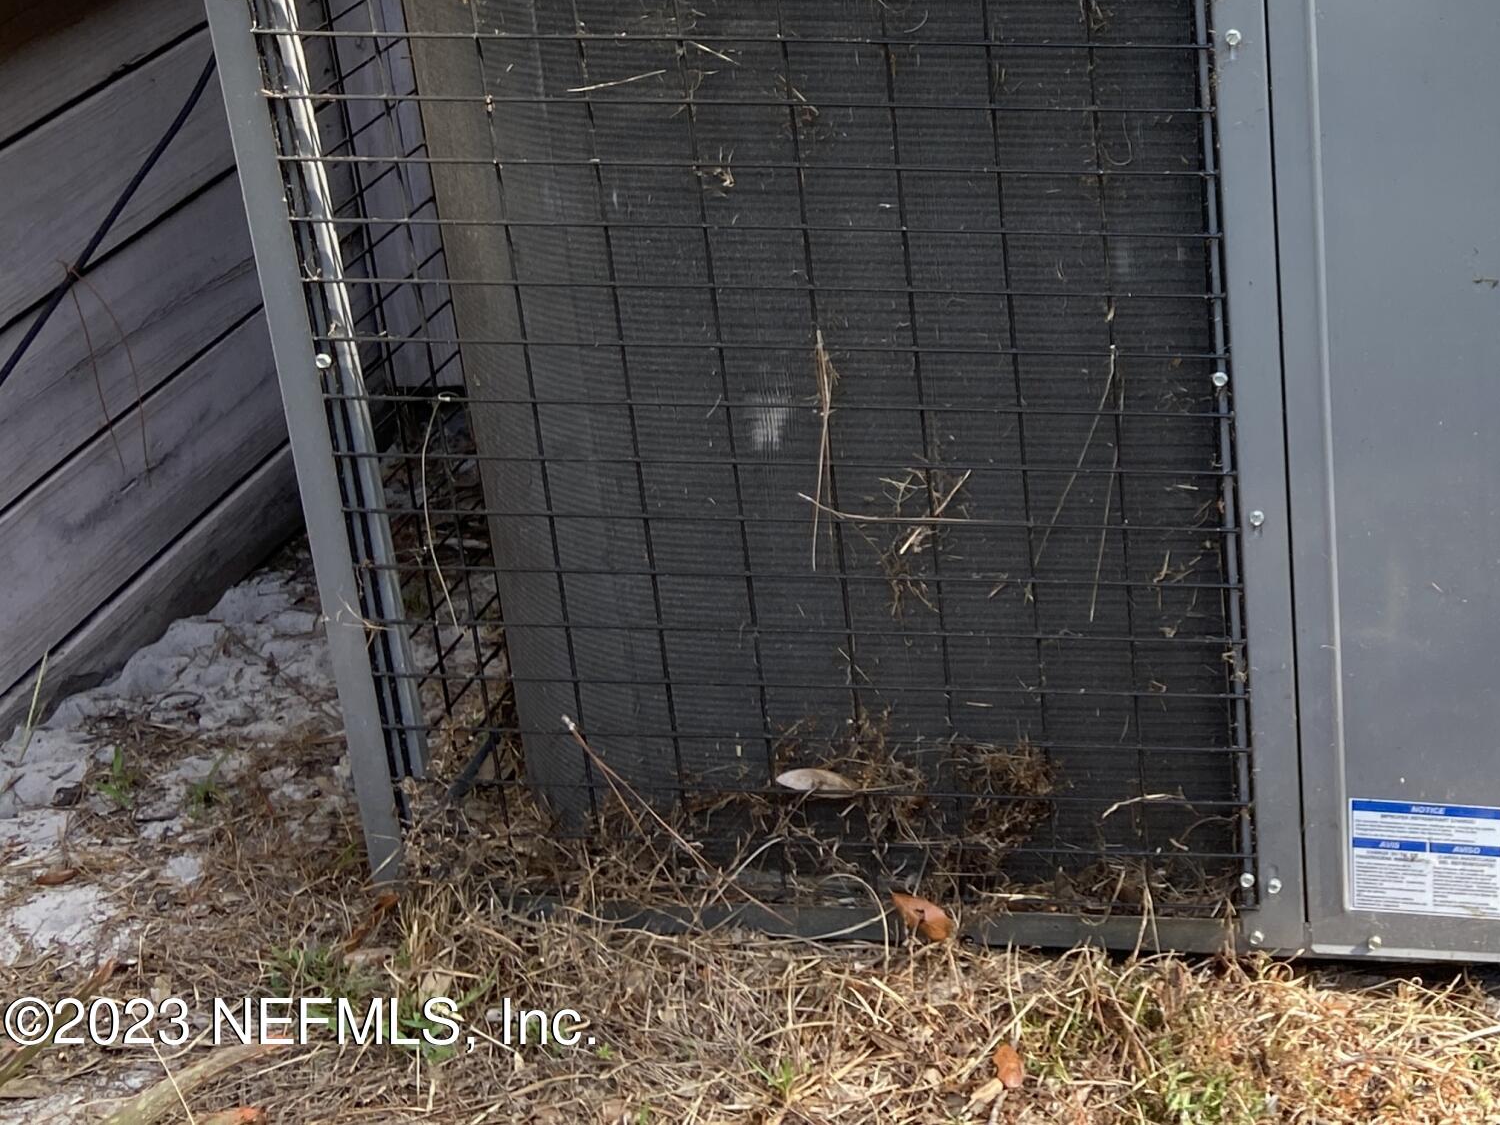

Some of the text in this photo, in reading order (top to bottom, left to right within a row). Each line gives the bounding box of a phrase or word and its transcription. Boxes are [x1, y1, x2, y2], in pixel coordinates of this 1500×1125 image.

[1410, 806, 1445, 815] NOTICE
[1379, 841, 1400, 849] AVIS
[1453, 846, 1480, 854] AVISO
